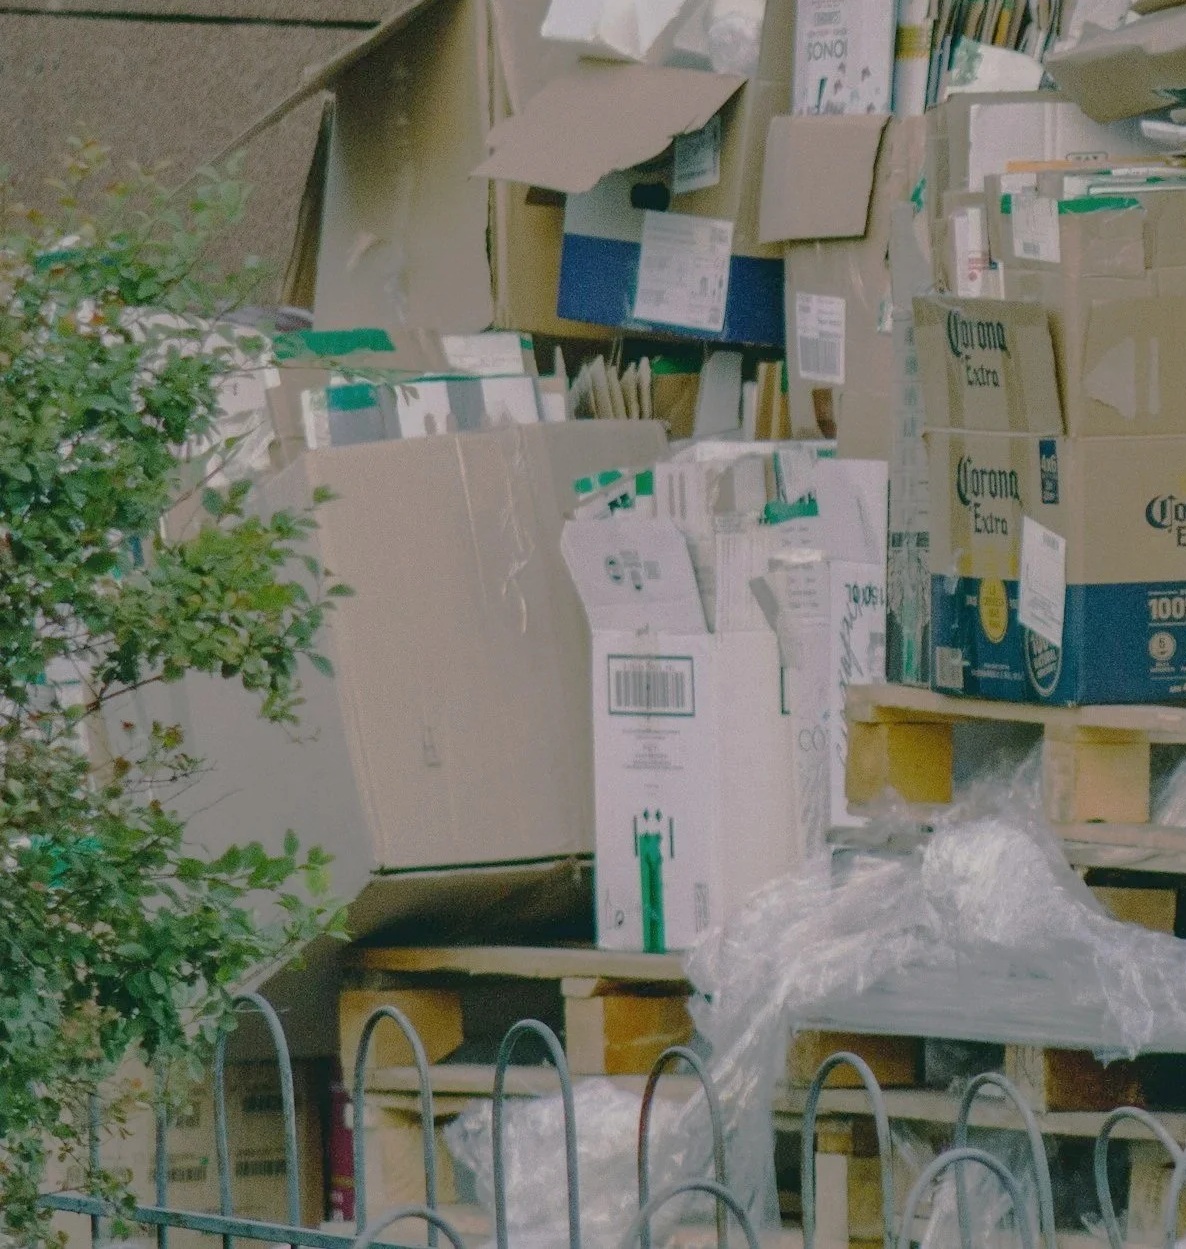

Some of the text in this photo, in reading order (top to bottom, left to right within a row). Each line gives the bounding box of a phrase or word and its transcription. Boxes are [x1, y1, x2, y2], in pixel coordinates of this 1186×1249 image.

[946, 309, 1010, 358] Corona
[965, 354, 1001, 388] Extra
[956, 455, 1021, 510] Corona
[973, 503, 1009, 536] Extra
